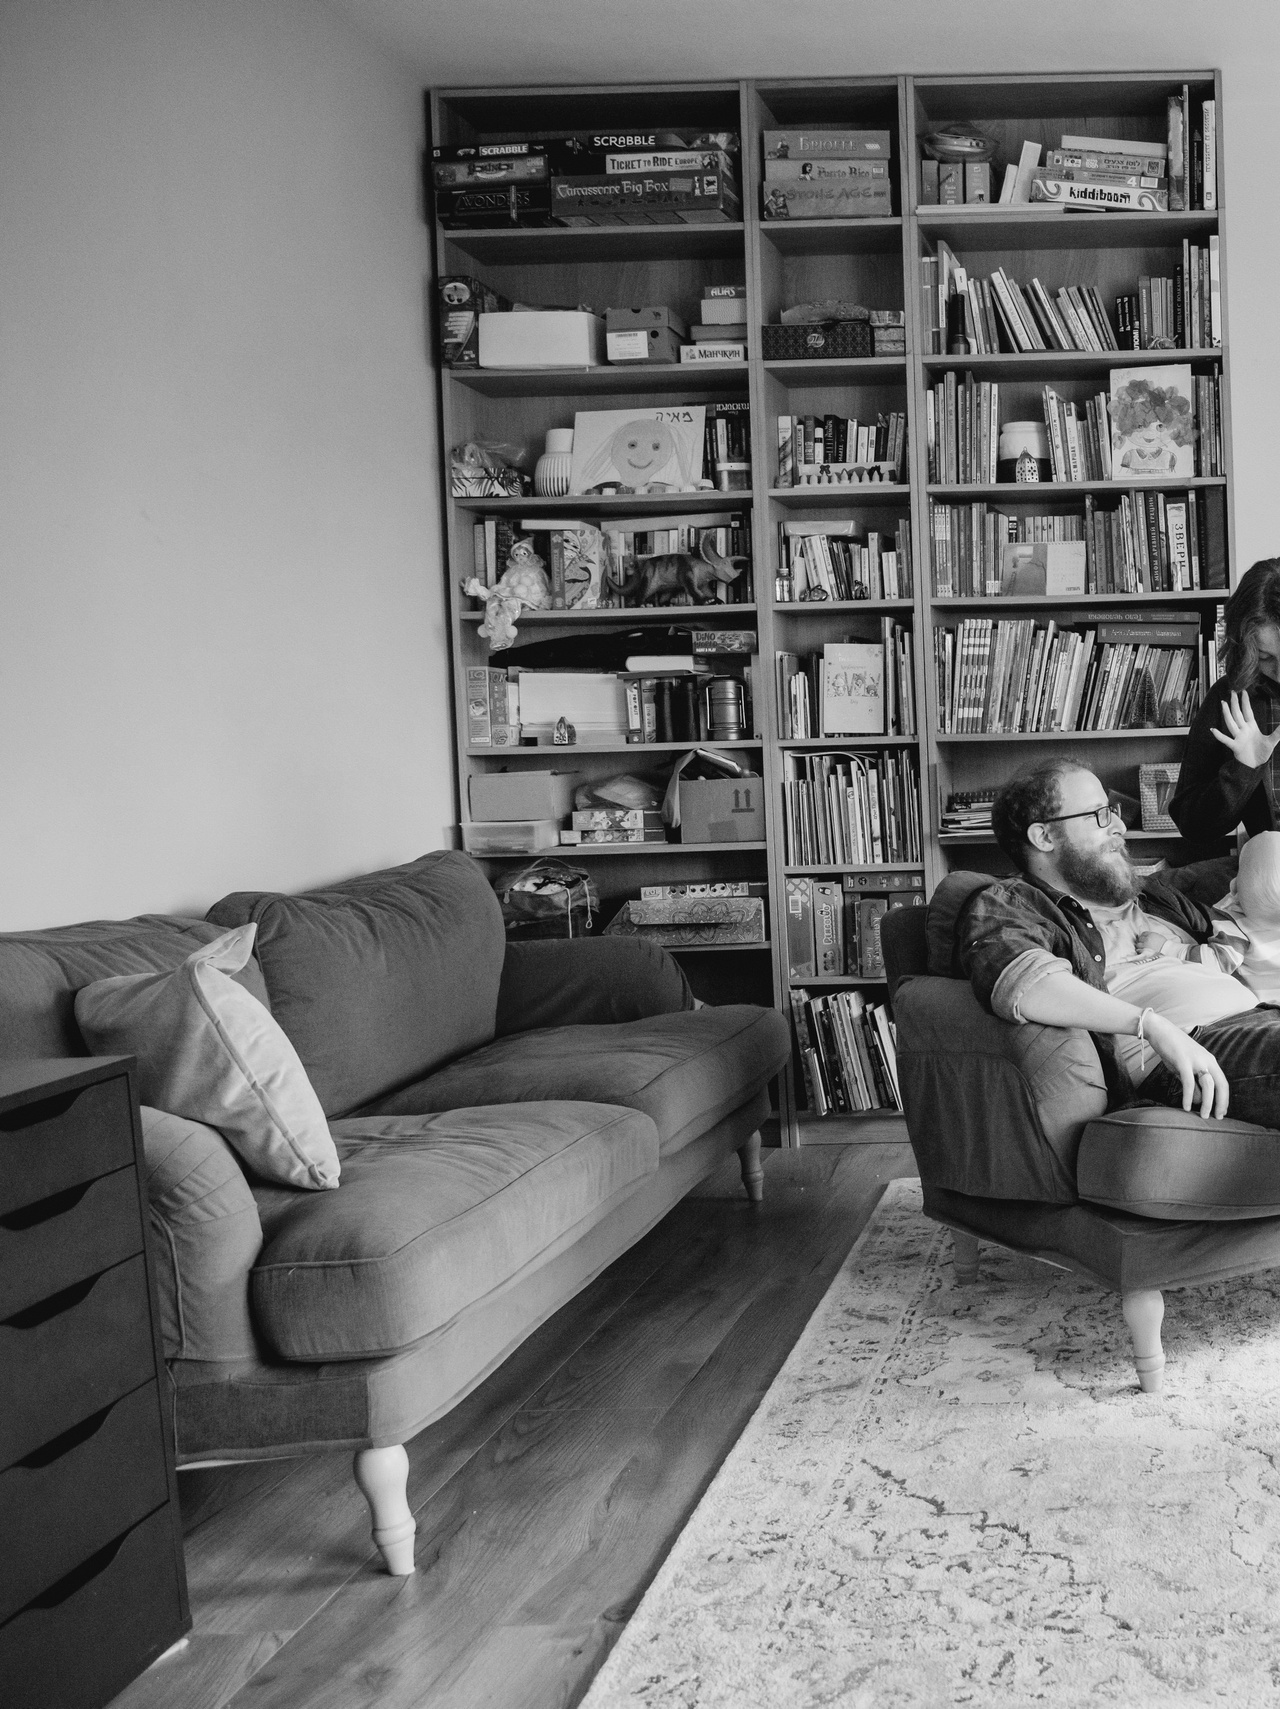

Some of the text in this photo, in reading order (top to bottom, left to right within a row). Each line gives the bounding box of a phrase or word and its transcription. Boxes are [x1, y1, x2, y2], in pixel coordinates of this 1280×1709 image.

[593, 135, 656, 148] SCRABBLE
[481, 145, 528, 156] SCRABBLE
[610, 158, 641, 170] TICKET
[652, 156, 673, 167] RIDE
[621, 180, 643, 196] Big
[644, 179, 669, 192] Box
[1127, 176, 1137, 187] 4
[1069, 187, 1131, 204] kiddiboom
[698, 349, 741, 360] Манчкин
[655, 411, 694, 423] מאיה
[1148, 496, 1156, 524] ГРЕЦИИ
[1150, 526, 1158, 557] ДРЕВНЕЙ
[469, 670, 486, 680] IQ
